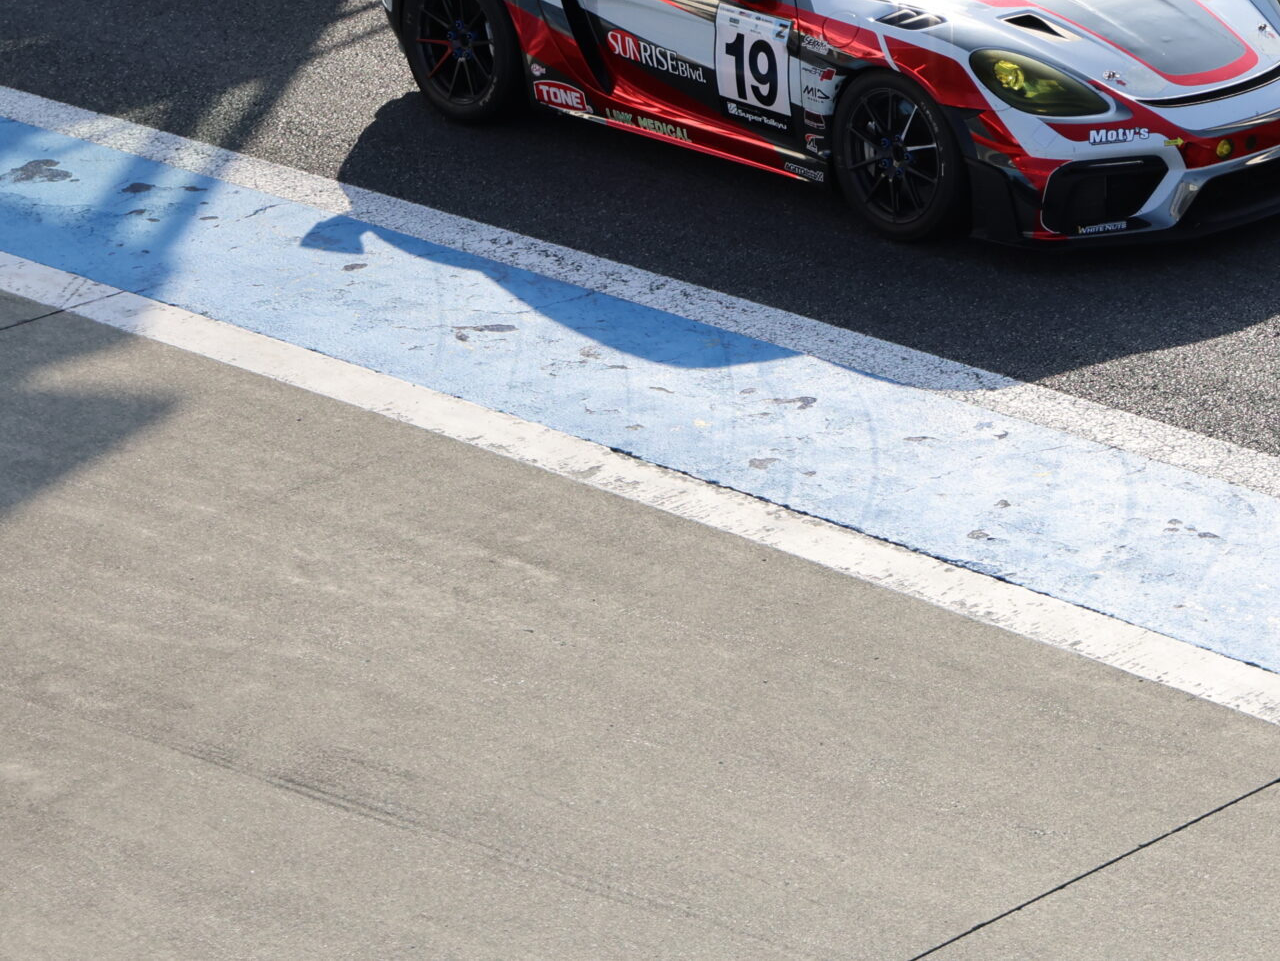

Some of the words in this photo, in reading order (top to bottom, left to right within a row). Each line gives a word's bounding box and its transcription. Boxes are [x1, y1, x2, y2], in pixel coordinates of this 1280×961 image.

[725, 33, 779, 107] 19
[538, 84, 583, 109] TONE
[637, 115, 692, 143] MEDICAL
[1089, 127, 1149, 145] Moty's
